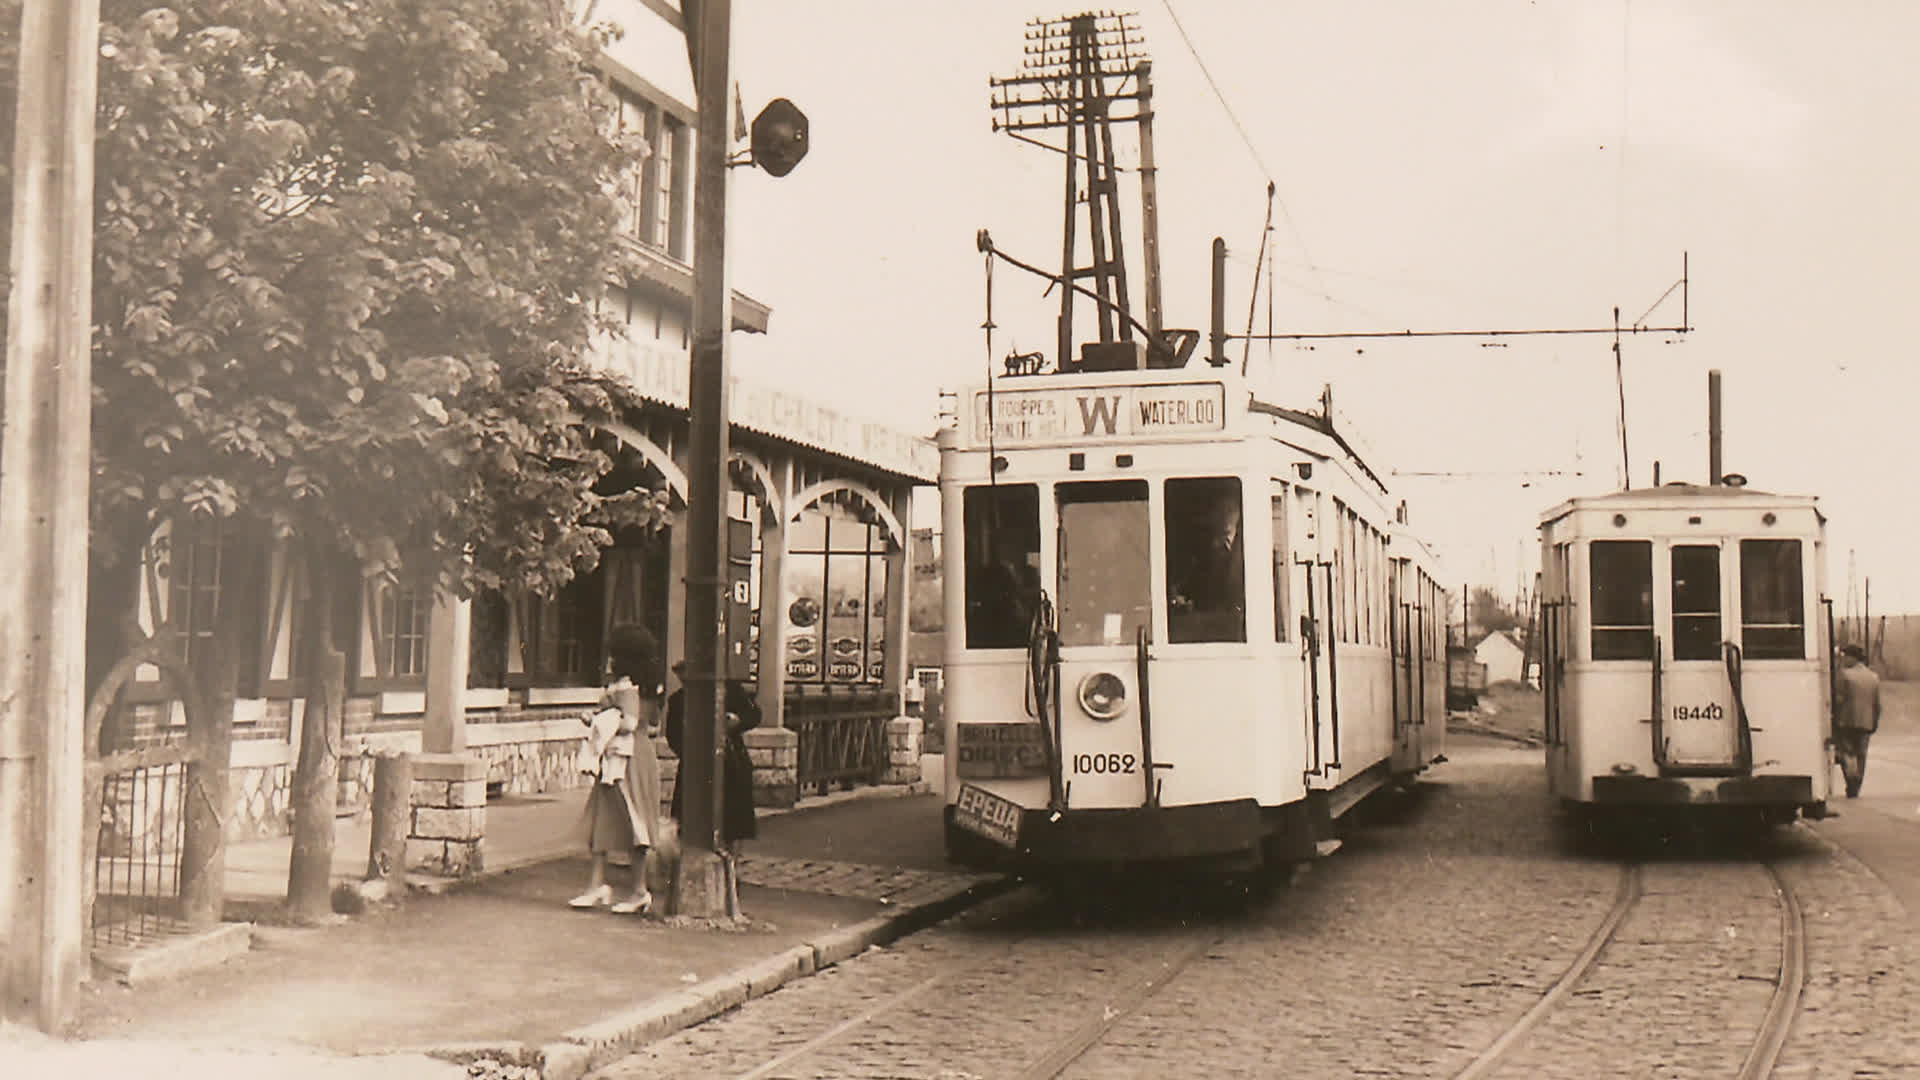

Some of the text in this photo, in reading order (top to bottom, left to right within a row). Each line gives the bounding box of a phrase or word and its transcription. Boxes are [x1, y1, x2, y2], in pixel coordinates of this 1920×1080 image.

[1076, 396, 1121, 435] W
[1139, 400, 1214, 426] WATERLOO
[1673, 705, 1723, 720] 19440
[1074, 754, 1136, 774] 10062
[959, 786, 1019, 832] EPEDA
